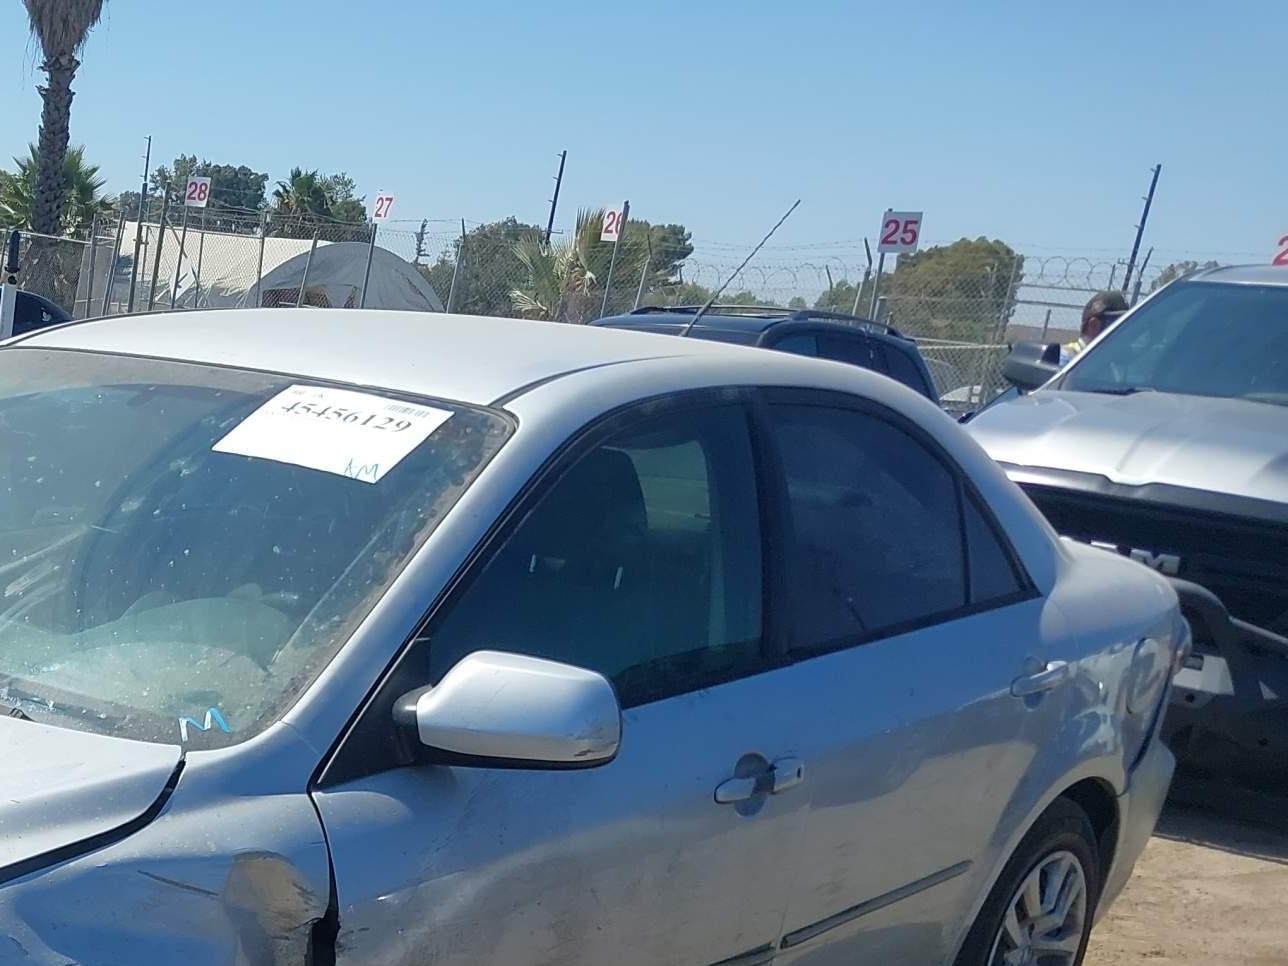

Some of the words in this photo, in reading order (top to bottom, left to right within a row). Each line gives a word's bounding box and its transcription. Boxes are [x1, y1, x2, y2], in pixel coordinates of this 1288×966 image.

[186, 181, 207, 201] 28
[374, 196, 394, 218] 27
[881, 219, 919, 246] 25
[281, 400, 412, 432] 45456129
